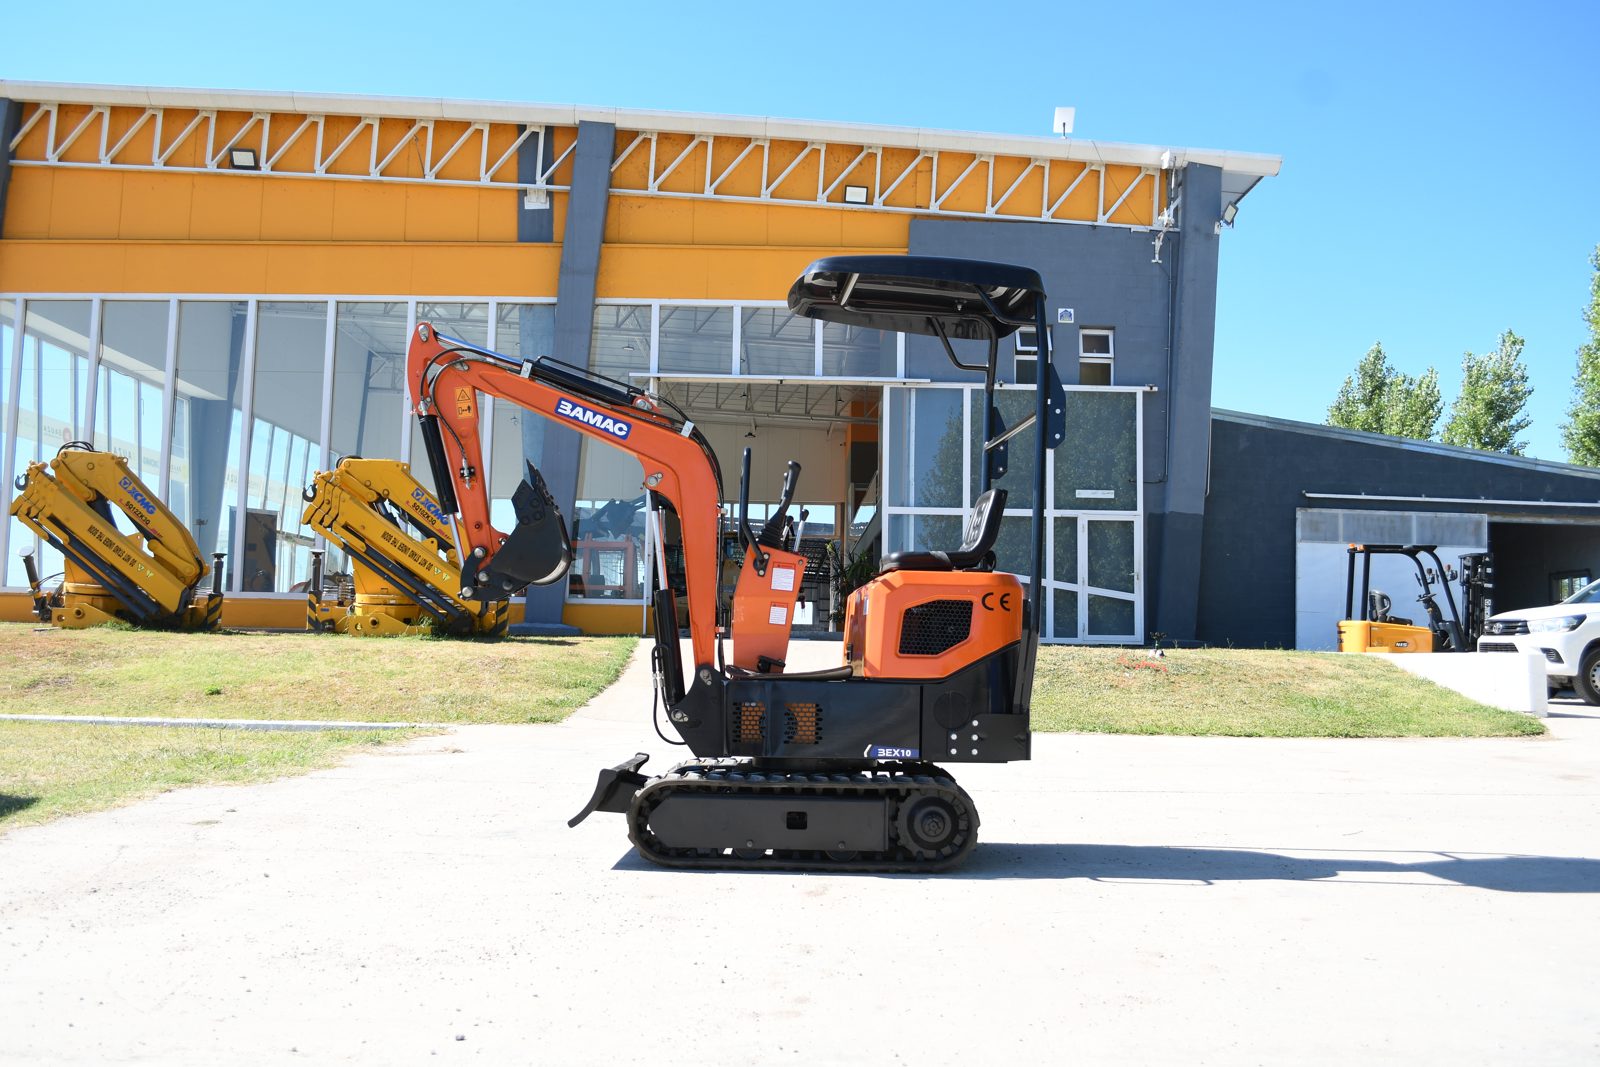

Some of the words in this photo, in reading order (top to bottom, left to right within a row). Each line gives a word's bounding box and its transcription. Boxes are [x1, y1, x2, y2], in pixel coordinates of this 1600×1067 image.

[557, 400, 628, 436] BAMAC
[128, 486, 157, 515] XCMG
[981, 592, 1011, 611] CE
[877, 748, 912, 757] BEX10
